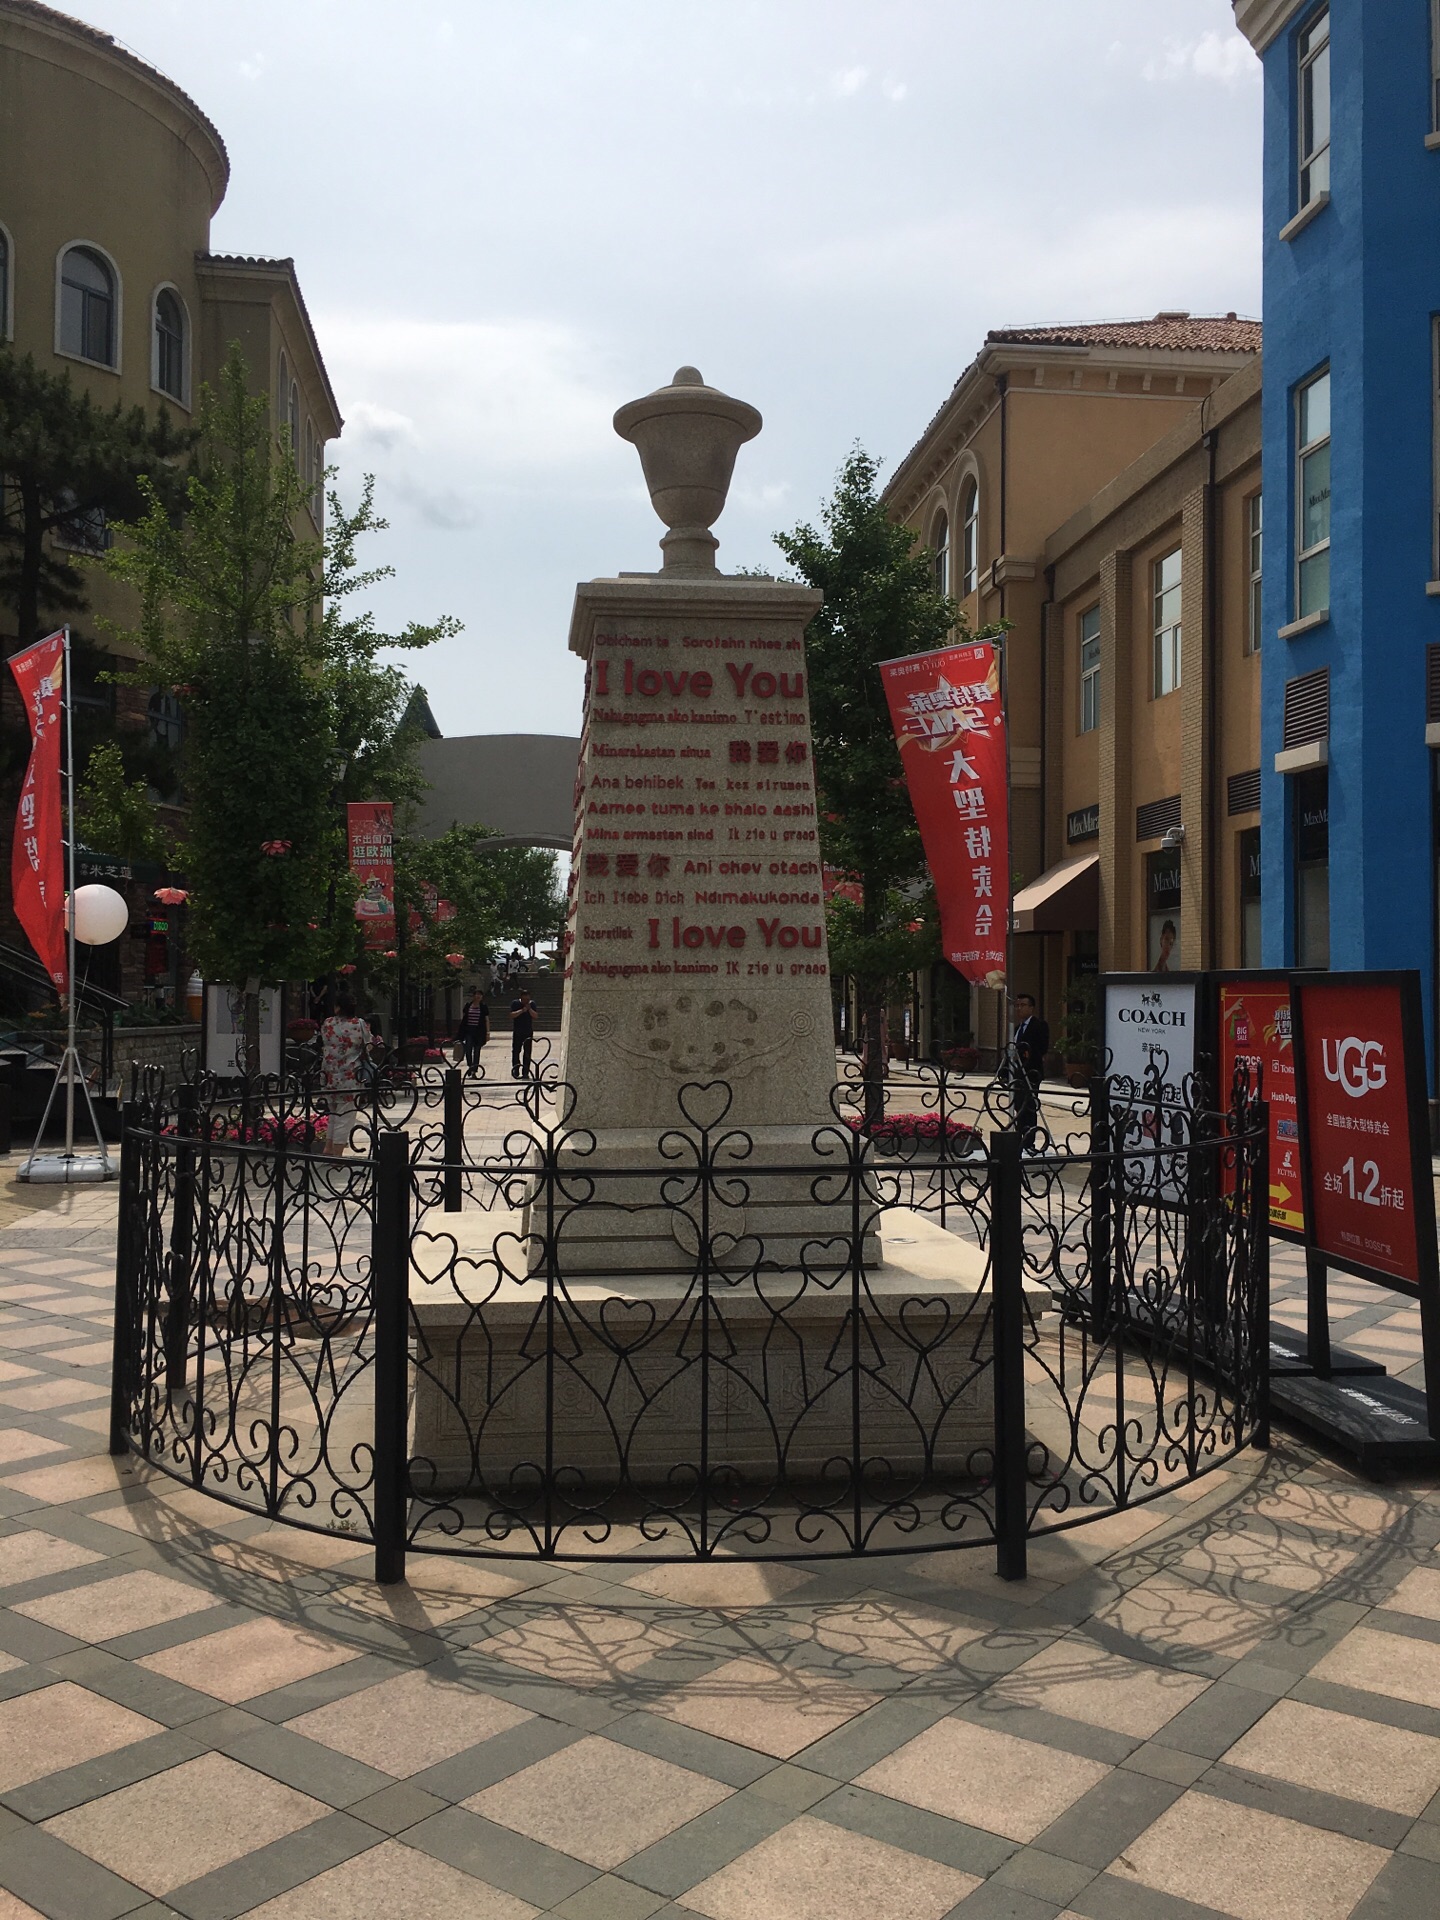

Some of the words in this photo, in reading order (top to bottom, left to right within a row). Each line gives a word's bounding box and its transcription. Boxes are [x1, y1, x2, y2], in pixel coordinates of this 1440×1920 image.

[596, 660, 609, 695] I
[624, 659, 713, 697] love
[726, 662, 804, 698] You
[591, 775, 620, 788] Ana
[625, 775, 684, 789] behibek
[587, 802, 645, 814] Aamee
[700, 803, 719, 815] ke
[770, 830, 777, 840] u
[352, 846, 392, 858] 逛欧洲
[684, 860, 712, 875] Ani
[719, 861, 762, 875] ohev
[769, 861, 818, 875] otach
[648, 918, 660, 948] I
[673, 916, 746, 948] love
[756, 917, 822, 948] You
[673, 961, 719, 974] kanimo
[776, 963, 783, 975] u
[790, 963, 827, 976] graag
[1118, 1008, 1186, 1027] COACH
[1236, 1026, 1247, 1035] BIG
[1321, 1036, 1387, 1098] UGG
[1271, 1091, 1285, 1102] Hush
